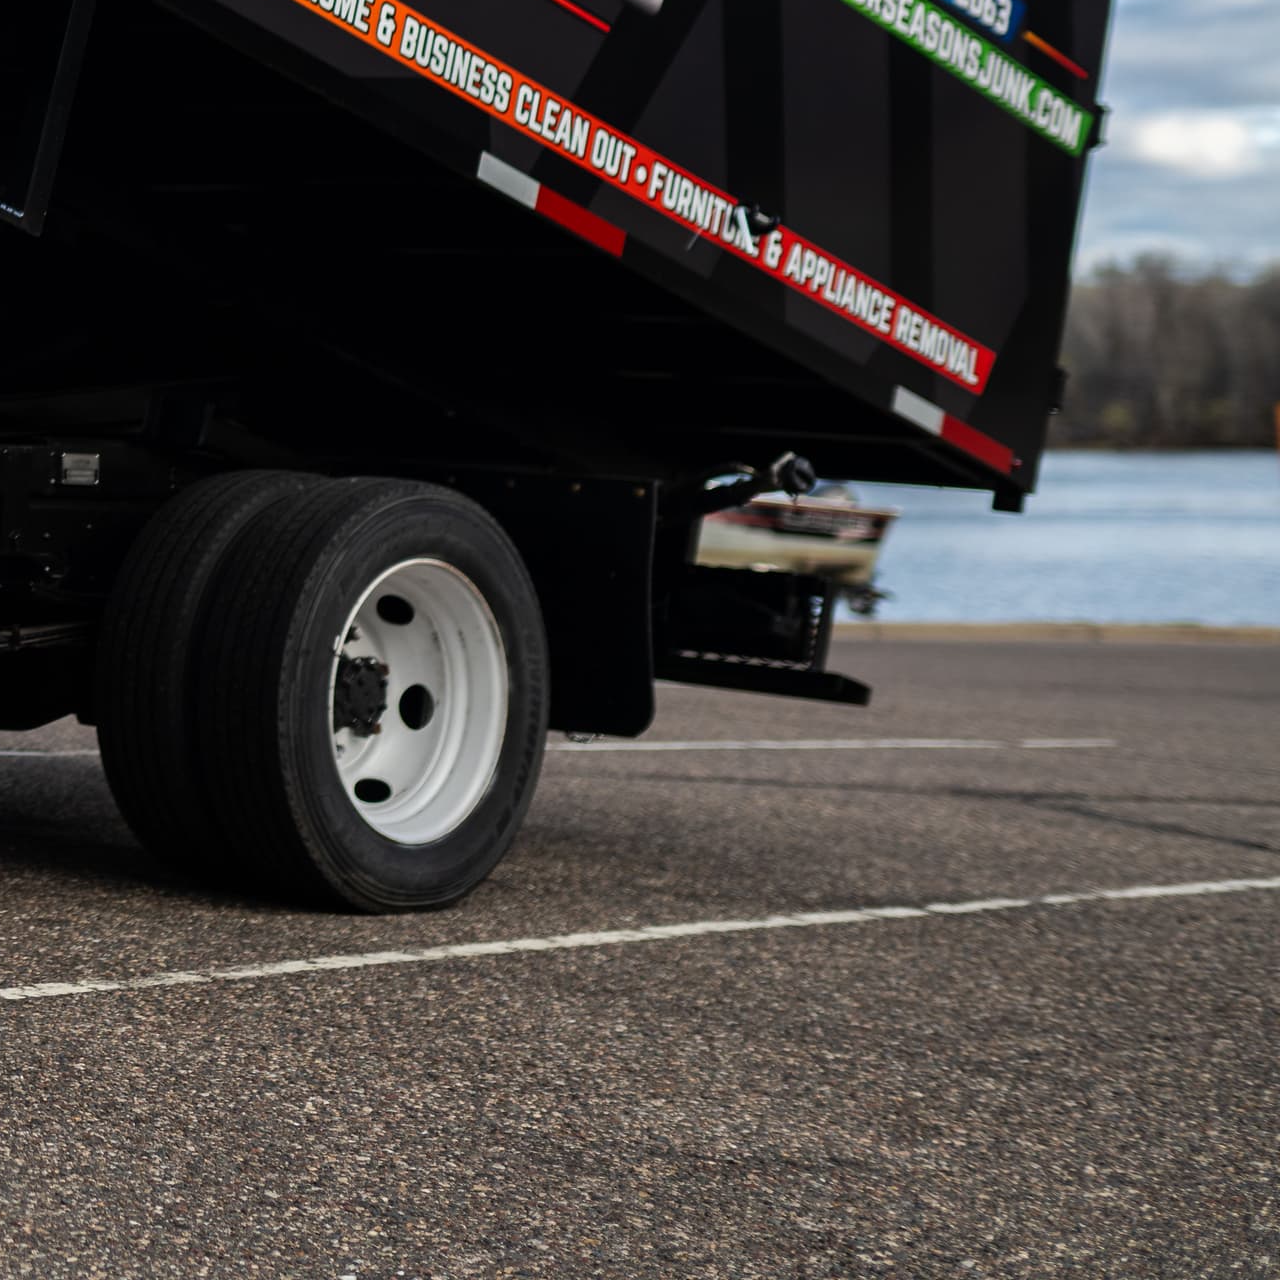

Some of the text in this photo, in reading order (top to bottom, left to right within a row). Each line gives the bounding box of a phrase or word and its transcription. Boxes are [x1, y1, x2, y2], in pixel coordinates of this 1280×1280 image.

[376, 2, 396, 46] &
[399, 16, 513, 113] BUSINESS
[514, 84, 590, 158] CLEAN
[591, 128, 637, 184] OUT
[648, 161, 760, 258] FURNITU
[764, 229, 783, 269] &
[783, 242, 896, 334] APPLIANCE
[895, 305, 980, 385] REMOVAL
